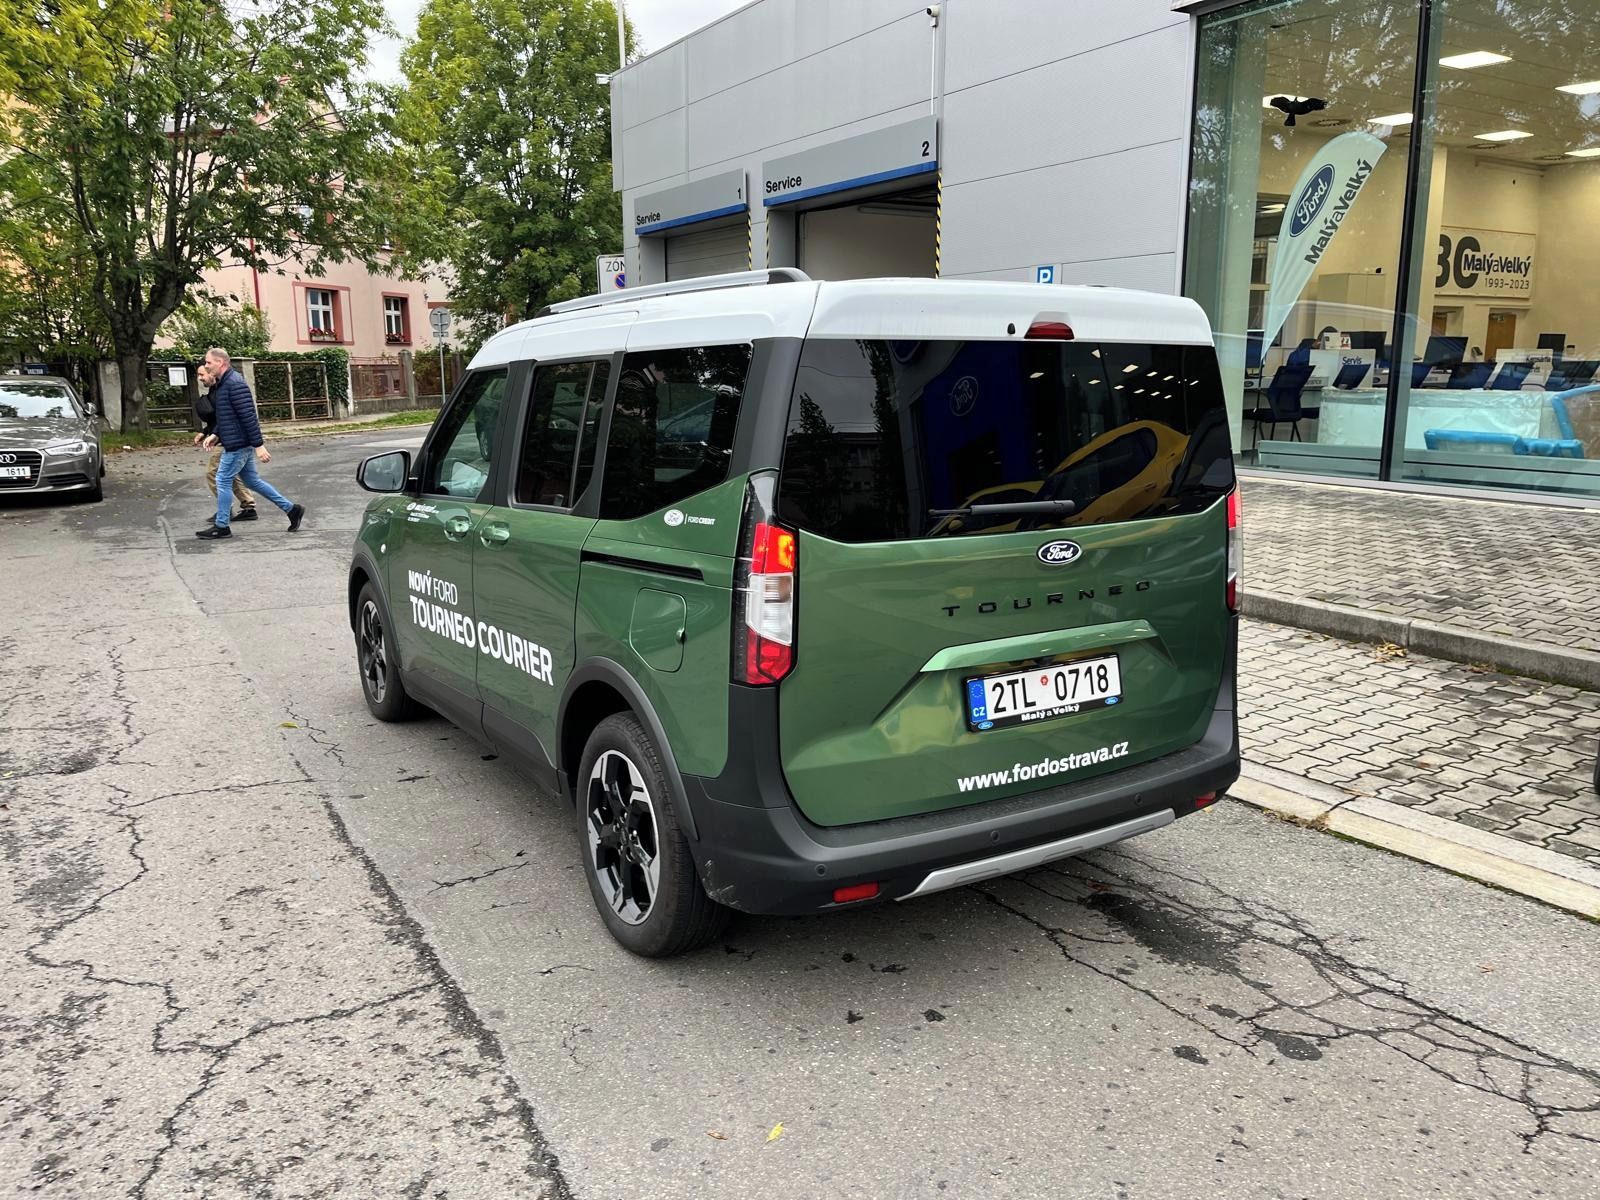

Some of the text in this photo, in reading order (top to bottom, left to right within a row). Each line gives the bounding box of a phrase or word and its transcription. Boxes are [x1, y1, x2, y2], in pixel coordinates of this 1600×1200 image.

[921, 140, 930, 158] 2
[737, 187, 742, 200] 1
[765, 174, 802, 195] Service
[1296, 178, 1328, 225] Ford
[636, 211, 661, 226] Service
[6, 468, 26, 476] 1611
[408, 570, 458, 606] NOVÝ FORD
[942, 580, 1151, 617] TOURNEO
[409, 595, 554, 687] TOURNEO COURIER
[992, 664, 1109, 714] 2TL 0718
[973, 707, 986, 718] CZ
[958, 741, 1129, 792] www.fordostrava.cz
